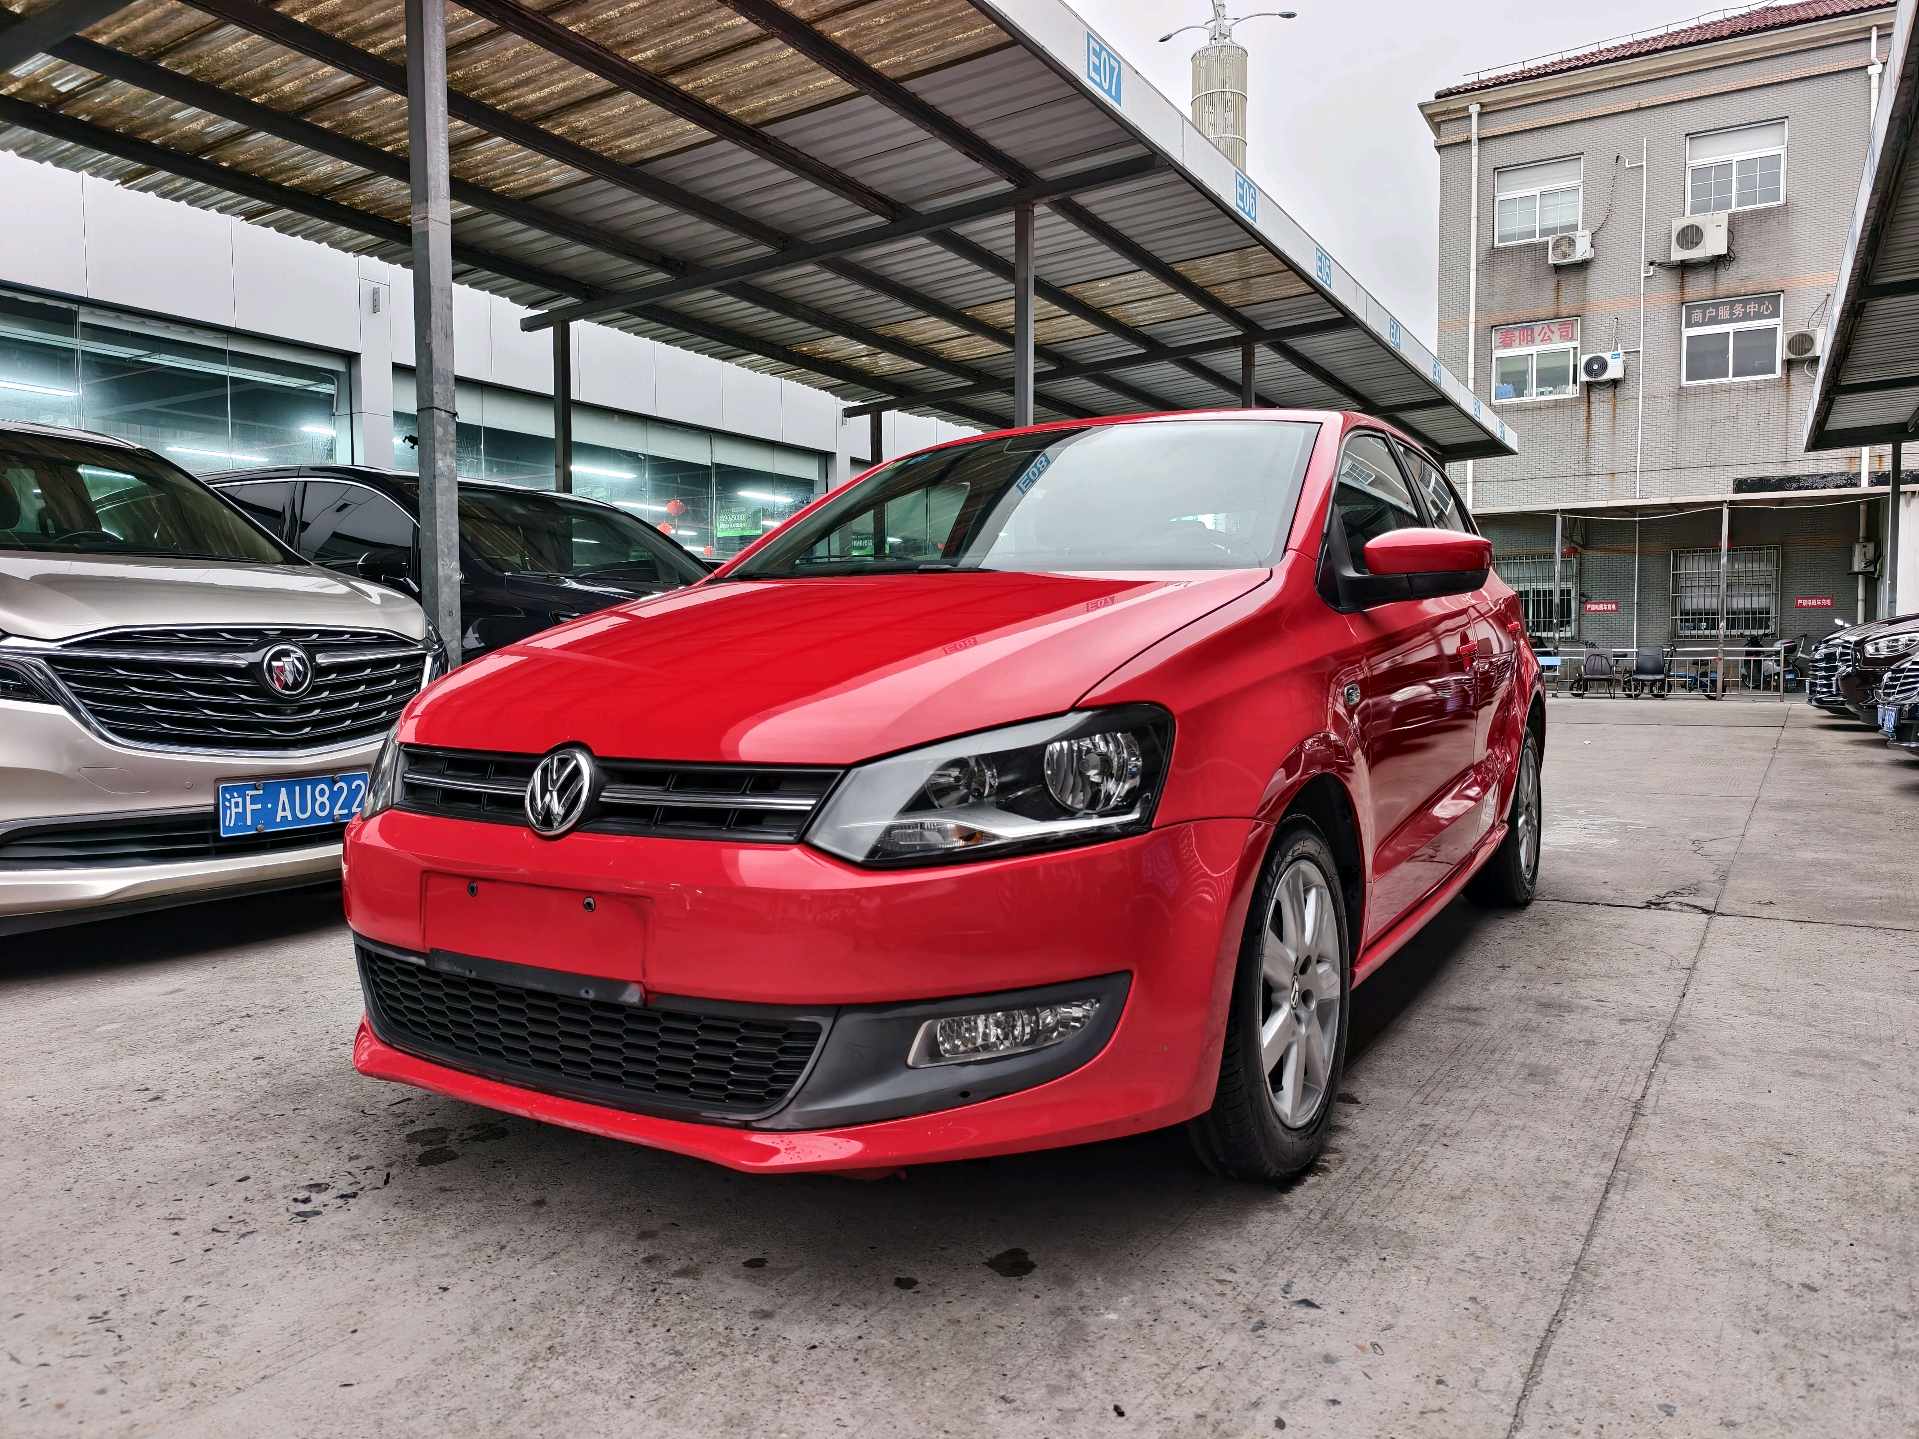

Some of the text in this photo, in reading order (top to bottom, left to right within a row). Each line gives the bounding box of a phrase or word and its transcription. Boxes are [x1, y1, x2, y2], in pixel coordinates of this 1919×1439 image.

[1089, 35, 1119, 97] E07
[1236, 176, 1257, 218] E06
[1691, 301, 1773, 324] 商户服务中心
